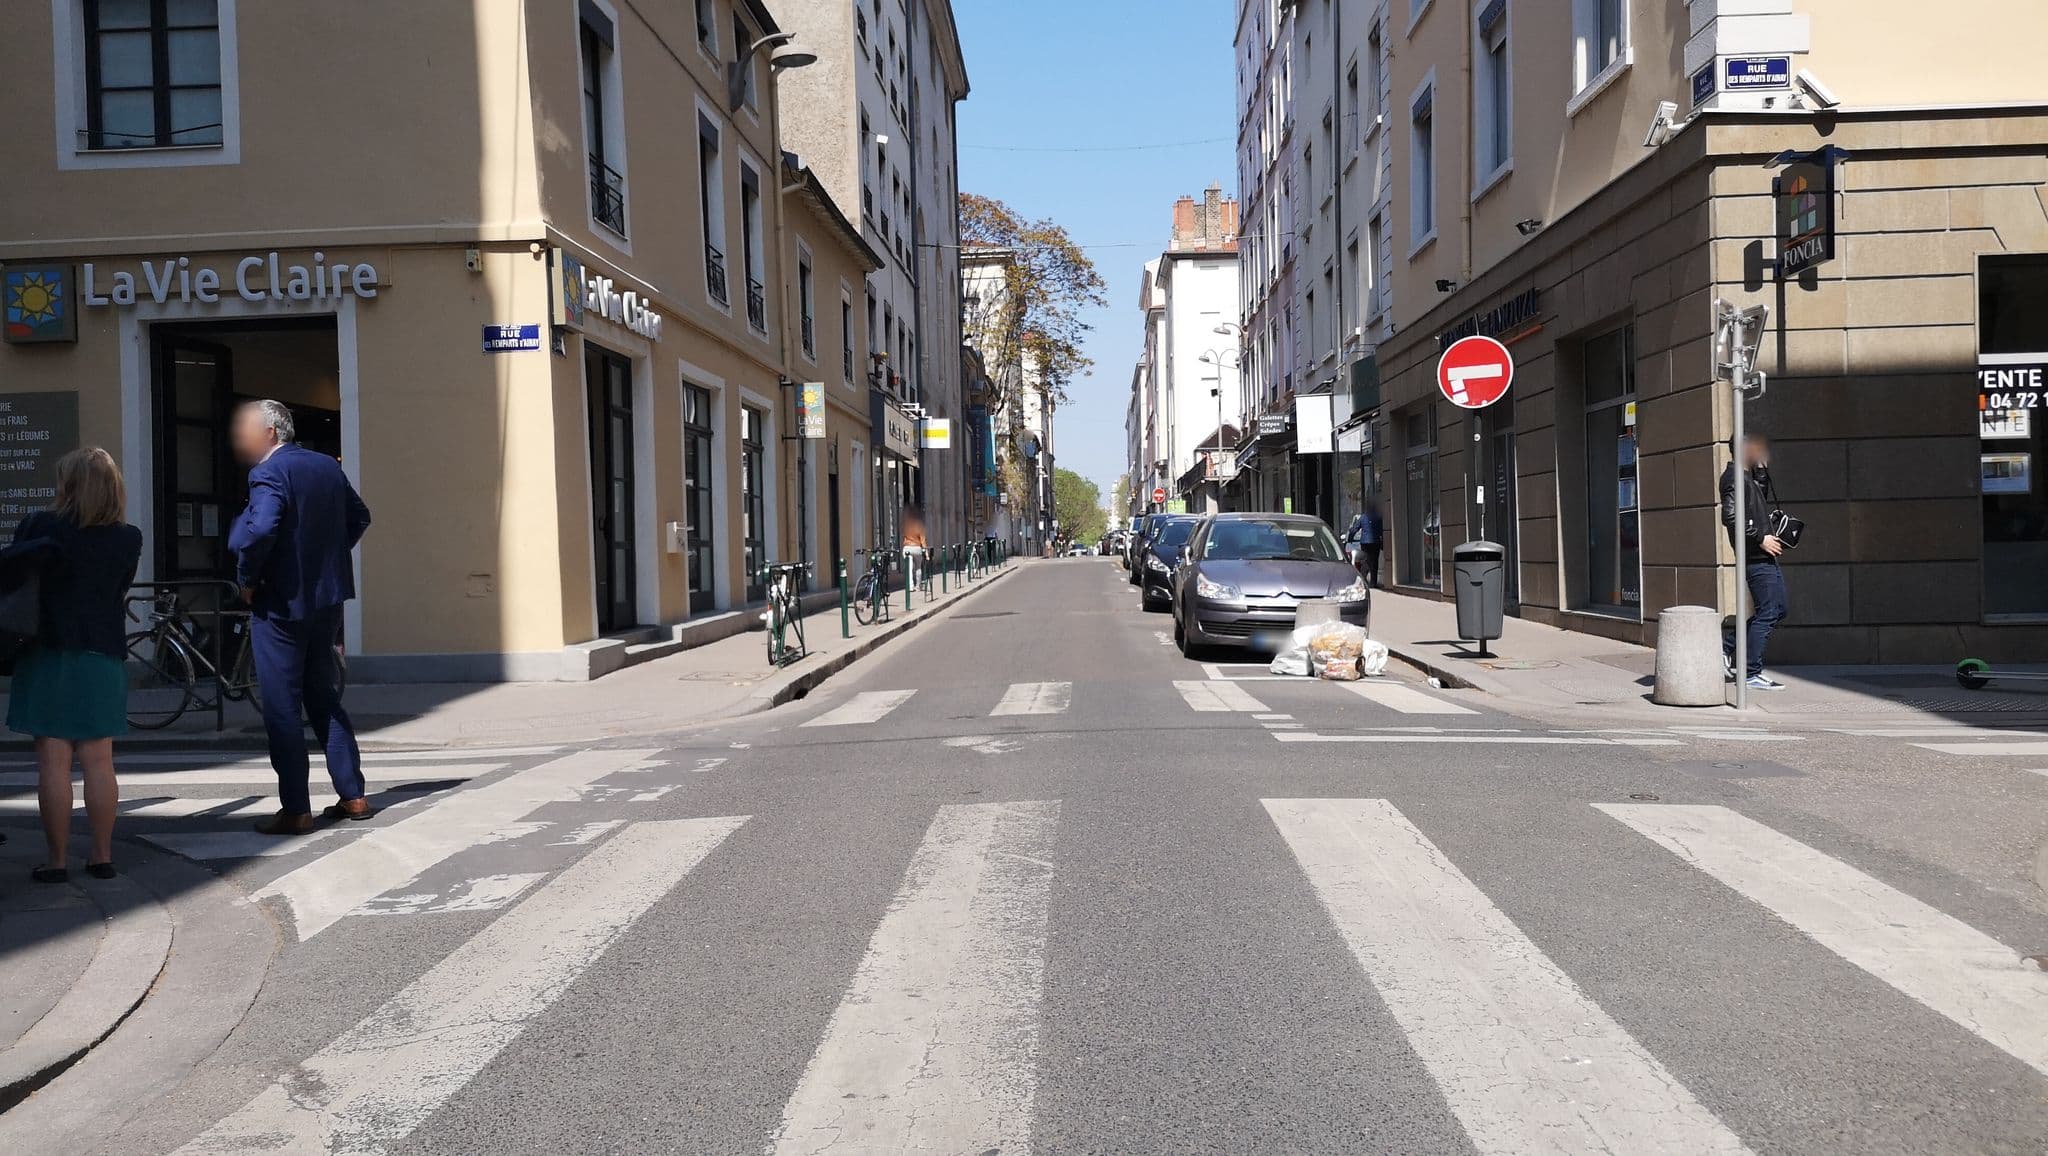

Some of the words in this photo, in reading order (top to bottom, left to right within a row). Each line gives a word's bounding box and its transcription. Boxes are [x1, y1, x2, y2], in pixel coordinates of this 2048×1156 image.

[1747, 64, 1767, 73] RUE
[1783, 236, 1823, 268] FONCIA
[235, 252, 378, 301] Claire
[500, 330, 521, 338] RUE
[1990, 393, 2012, 408] 04
[2015, 392, 2038, 408] 72
[7, 415, 28, 425] FRAIS
[16, 460, 35, 471] VRAC
[8, 487, 27, 498] SANS
[29, 487, 55, 498] GLUTEN
